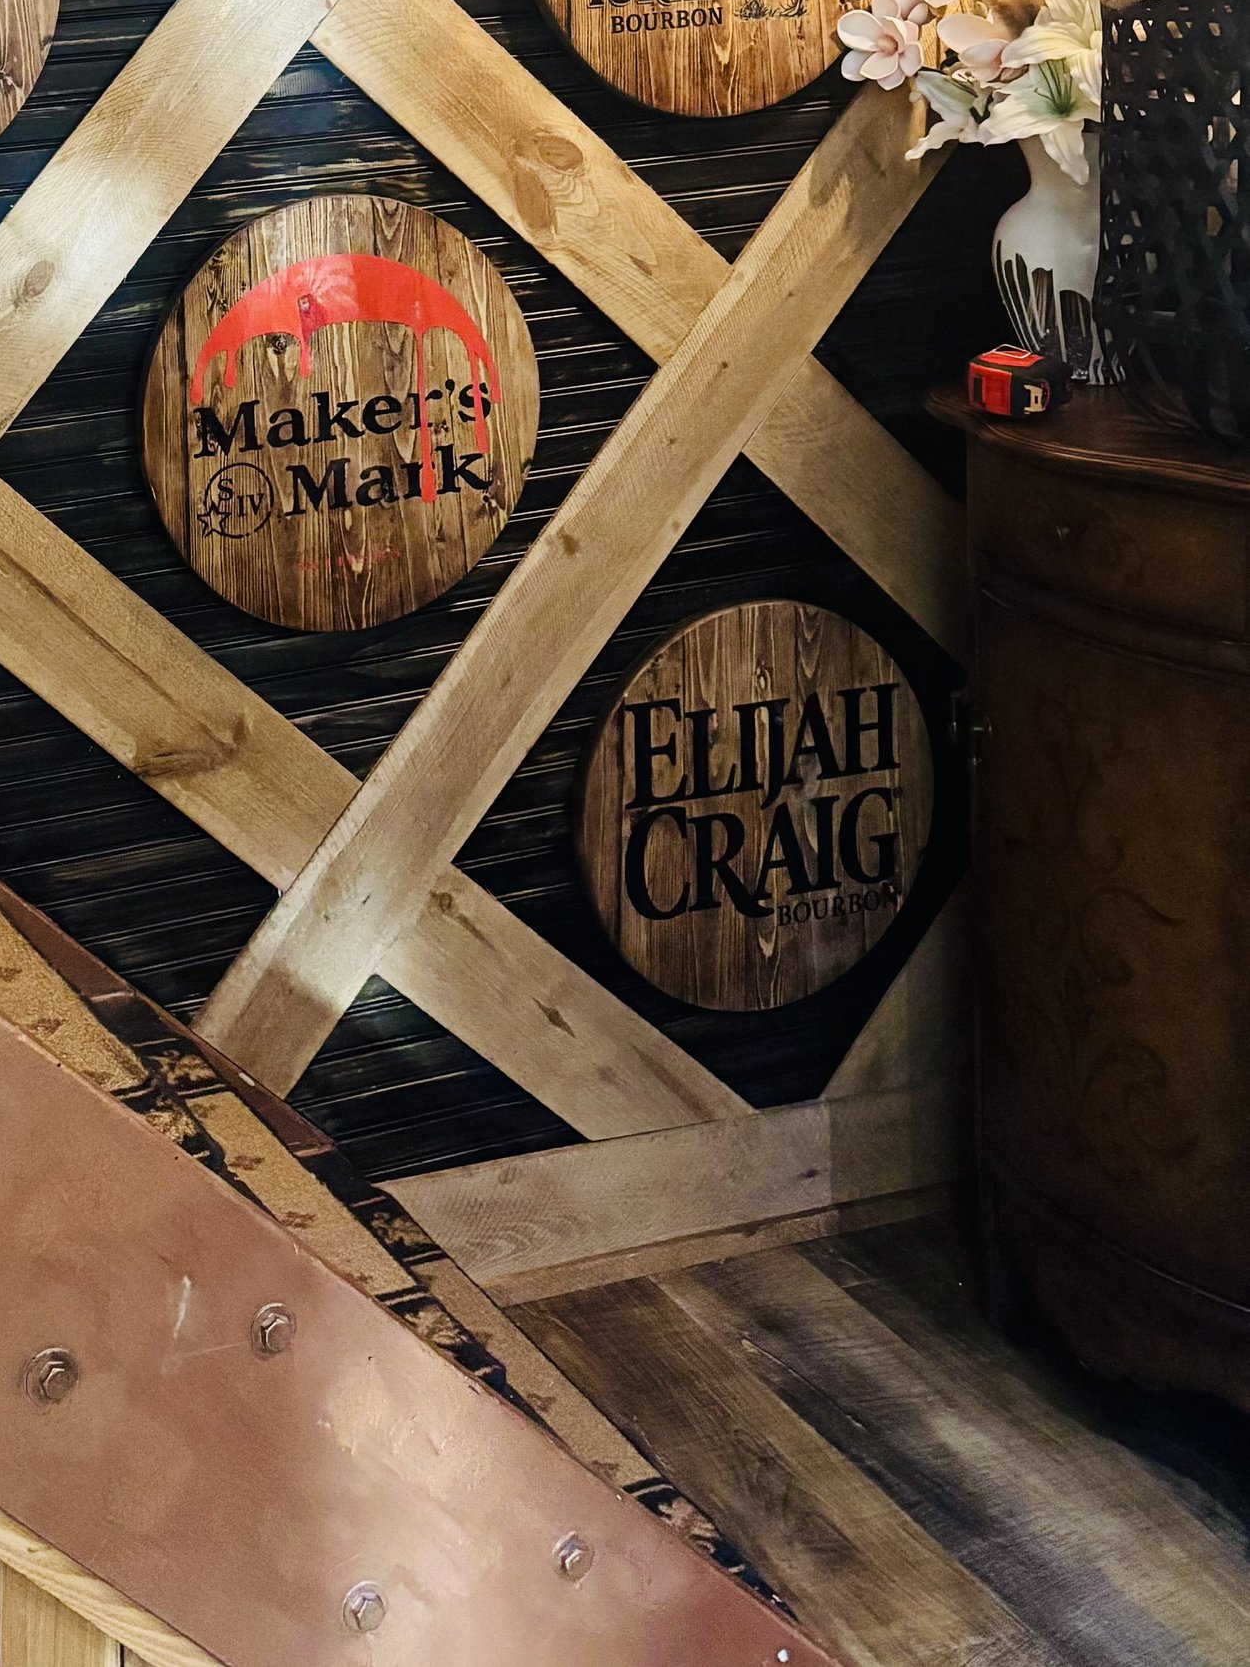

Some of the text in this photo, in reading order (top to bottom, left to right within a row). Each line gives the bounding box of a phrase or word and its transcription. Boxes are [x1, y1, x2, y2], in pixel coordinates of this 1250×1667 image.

[610, 6, 723, 34] BOURBON
[193, 377, 492, 460] Maker's
[625, 682, 901, 811] ELIJAH
[624, 786, 899, 921] CRAIG
